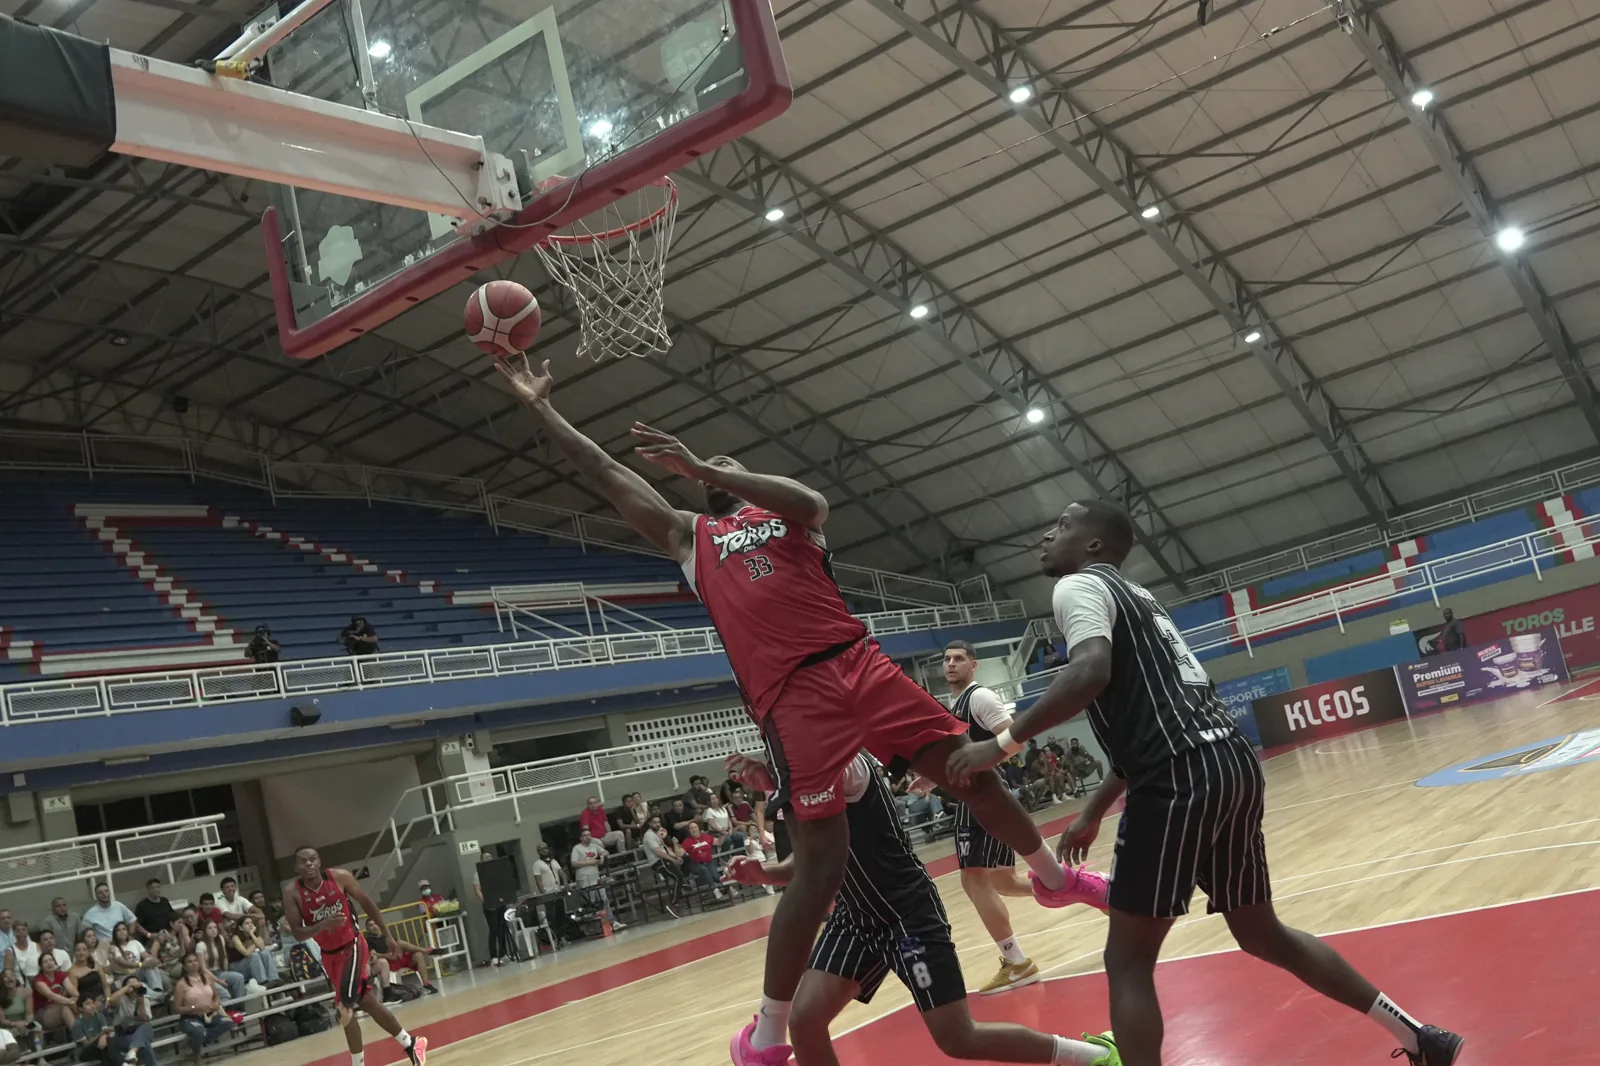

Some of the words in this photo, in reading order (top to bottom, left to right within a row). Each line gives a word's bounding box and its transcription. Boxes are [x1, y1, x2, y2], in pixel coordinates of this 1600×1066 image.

[743, 554, 774, 581] 33
[1502, 607, 1564, 635] TOROS
[1559, 616, 1595, 638] LLE
[1413, 665, 1462, 683] Premium
[1222, 687, 1267, 706] EPORTE
[1284, 685, 1370, 731] KLEOS
[912, 961, 932, 989] 8
